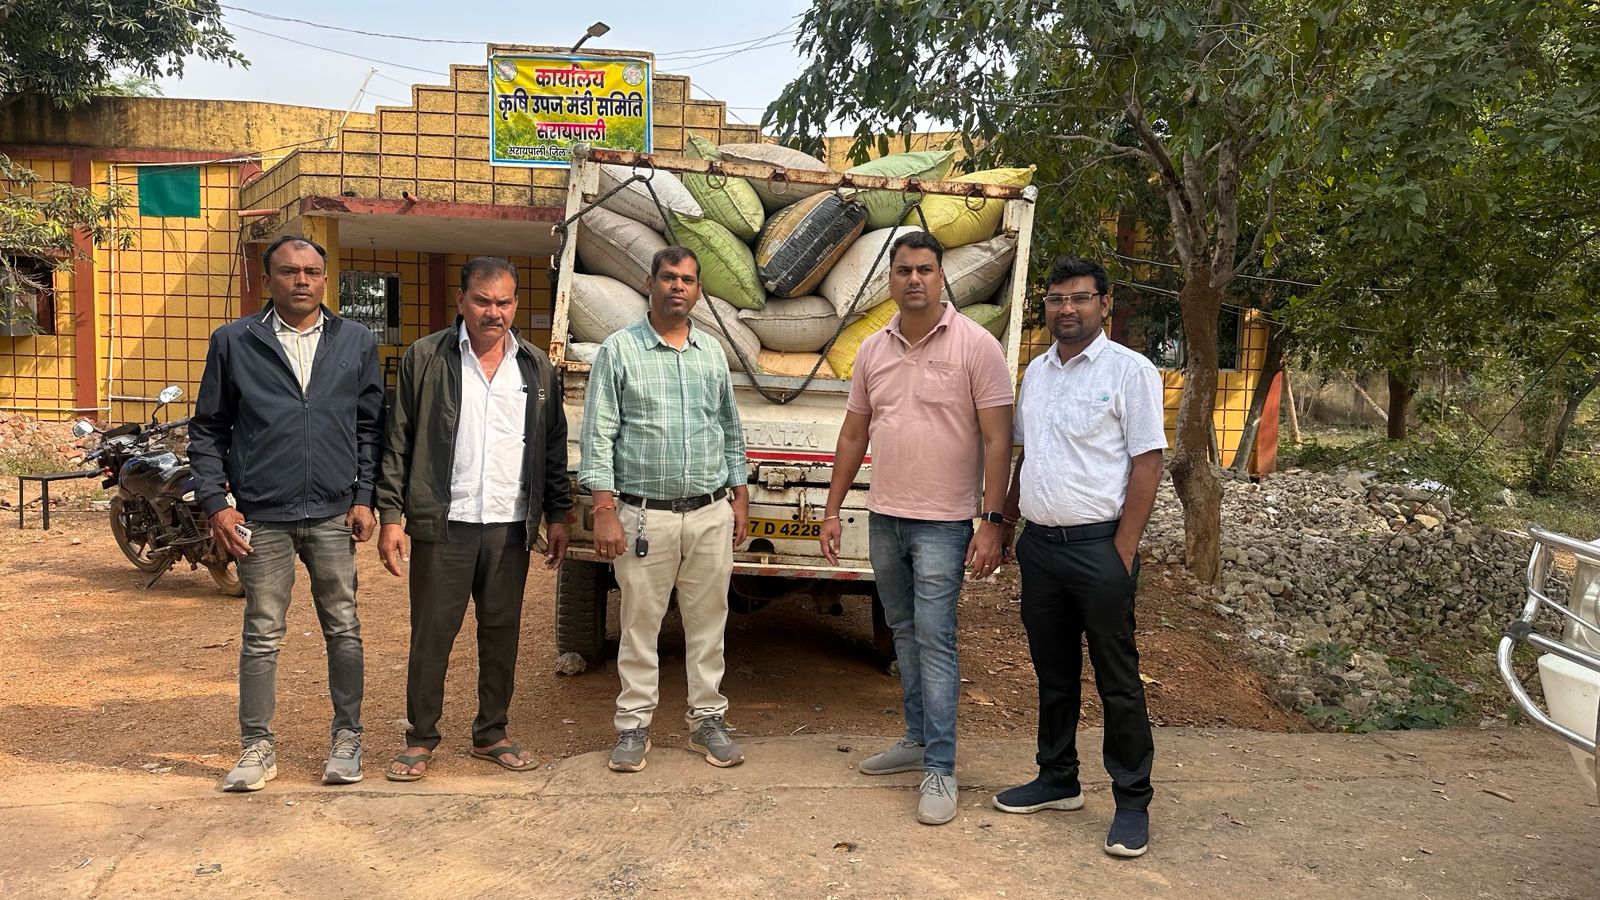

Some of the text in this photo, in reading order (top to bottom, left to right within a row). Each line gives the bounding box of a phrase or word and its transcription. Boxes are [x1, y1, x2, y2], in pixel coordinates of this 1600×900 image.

[535, 63, 605, 89] कार्यालय
[498, 87, 643, 120] कृषि उपज मंडी समिति
[536, 118, 606, 141] सरायपाली
[741, 423, 818, 448] TATA
[764, 521, 776, 535] D
[779, 523, 821, 537] 4228
